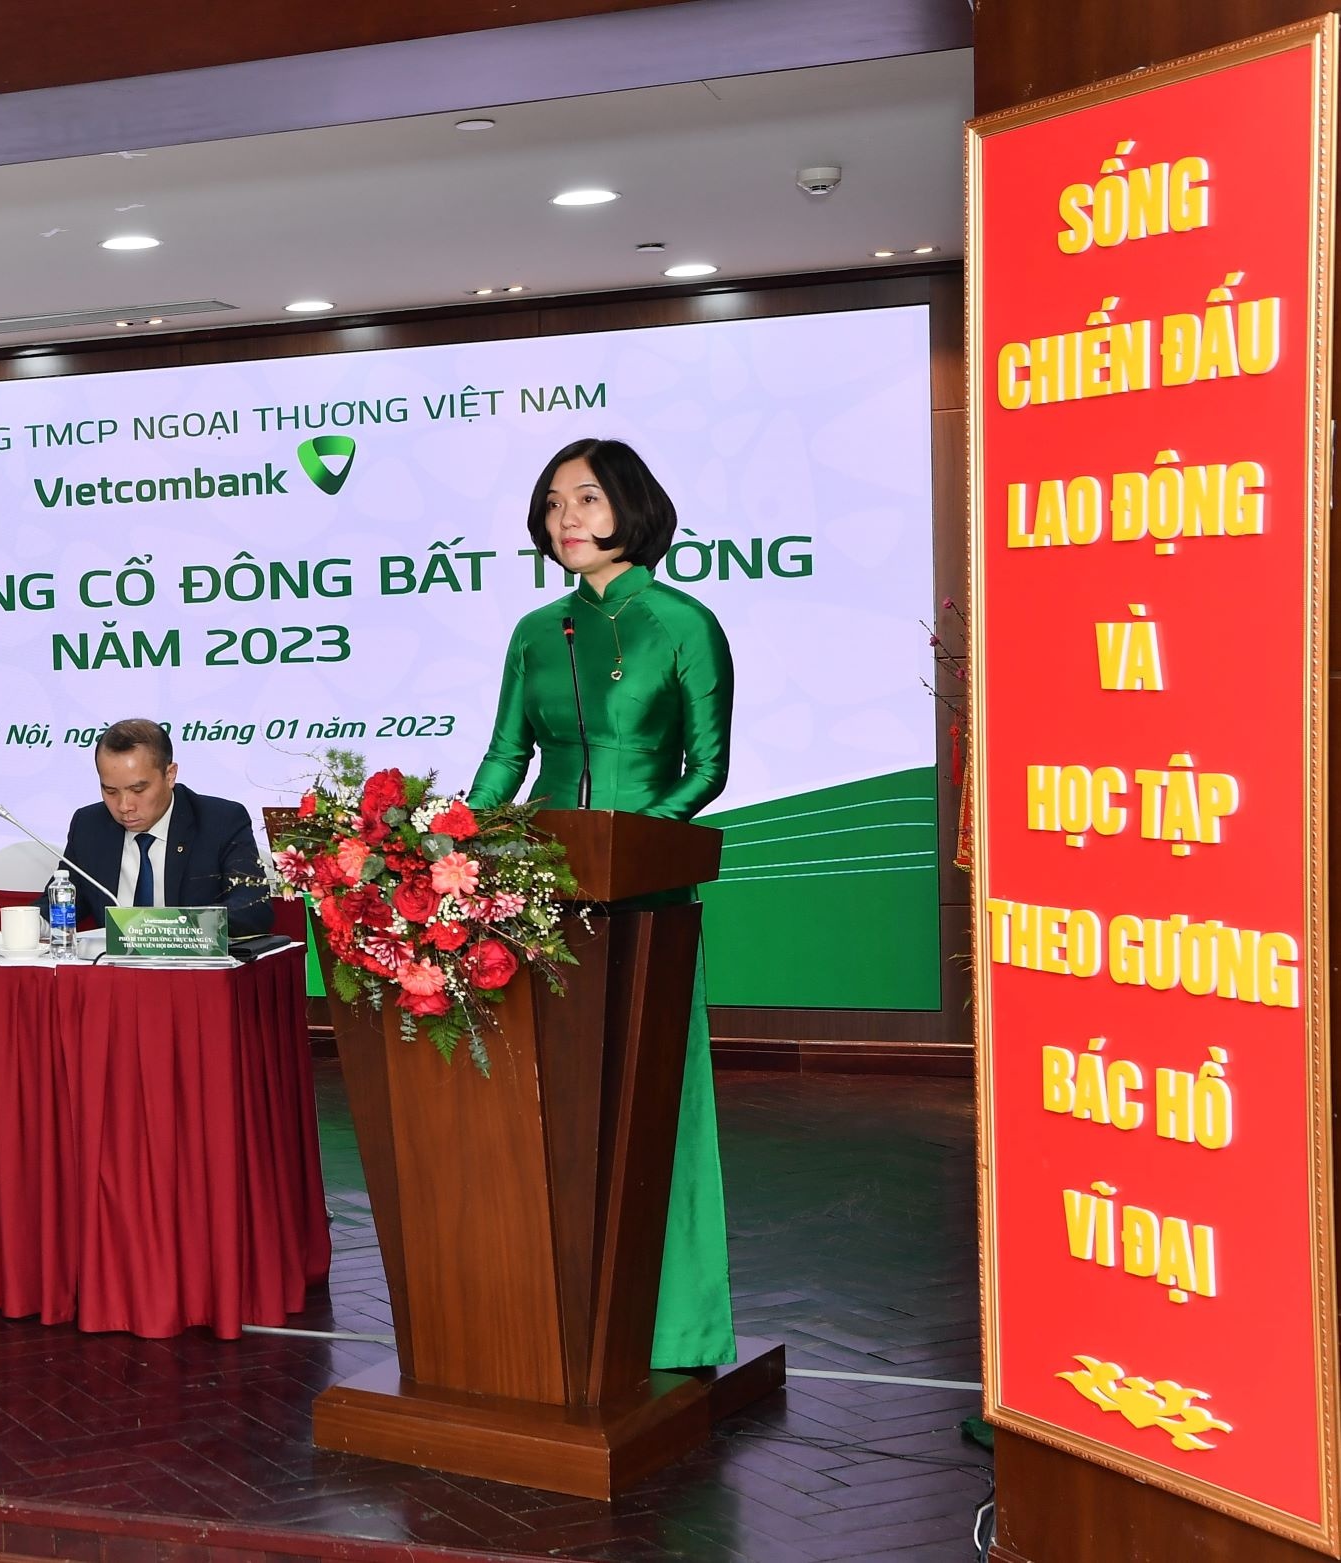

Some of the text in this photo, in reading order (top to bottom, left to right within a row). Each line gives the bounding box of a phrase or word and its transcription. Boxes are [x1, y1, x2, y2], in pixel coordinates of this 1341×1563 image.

[1058, 140, 1208, 254] SỐNG
[997, 271, 1280, 409] CHIẾN ĐẤU
[24, 419, 118, 448] TMCP
[133, 409, 239, 440] NGOẠI
[252, 397, 408, 432] THƯƠNG
[422, 384, 505, 423] VIỆT
[520, 382, 606, 414] NAM
[1008, 449, 1264, 555] LAO ĐỘNG
[79, 553, 155, 609] CỔ
[178, 550, 352, 604] ĐÔNG
[379, 536, 497, 596] BẤT
[517, 528, 813, 589] TỜNG
[52, 620, 351, 671] NĂM 2023
[1095, 604, 1163, 690] VÀ
[5, 723, 53, 748] Nội,
[64, 722, 108, 748] ngà
[181, 719, 256, 746] tháng
[265, 719, 299, 740] 01
[305, 716, 367, 739] năm
[375, 715, 456, 738] 2023
[1026, 753, 1238, 856] HỌC TẬP
[128, 925, 143, 936] Ông
[157, 927, 178, 936] VIỆT
[178, 926, 203, 935] HÙNG
[987, 898, 1299, 1008] THEO GƯƠNG
[1042, 1037, 1232, 1149] BÁC HỒ
[1063, 1181, 1216, 1303] VĨ ĐẠI
